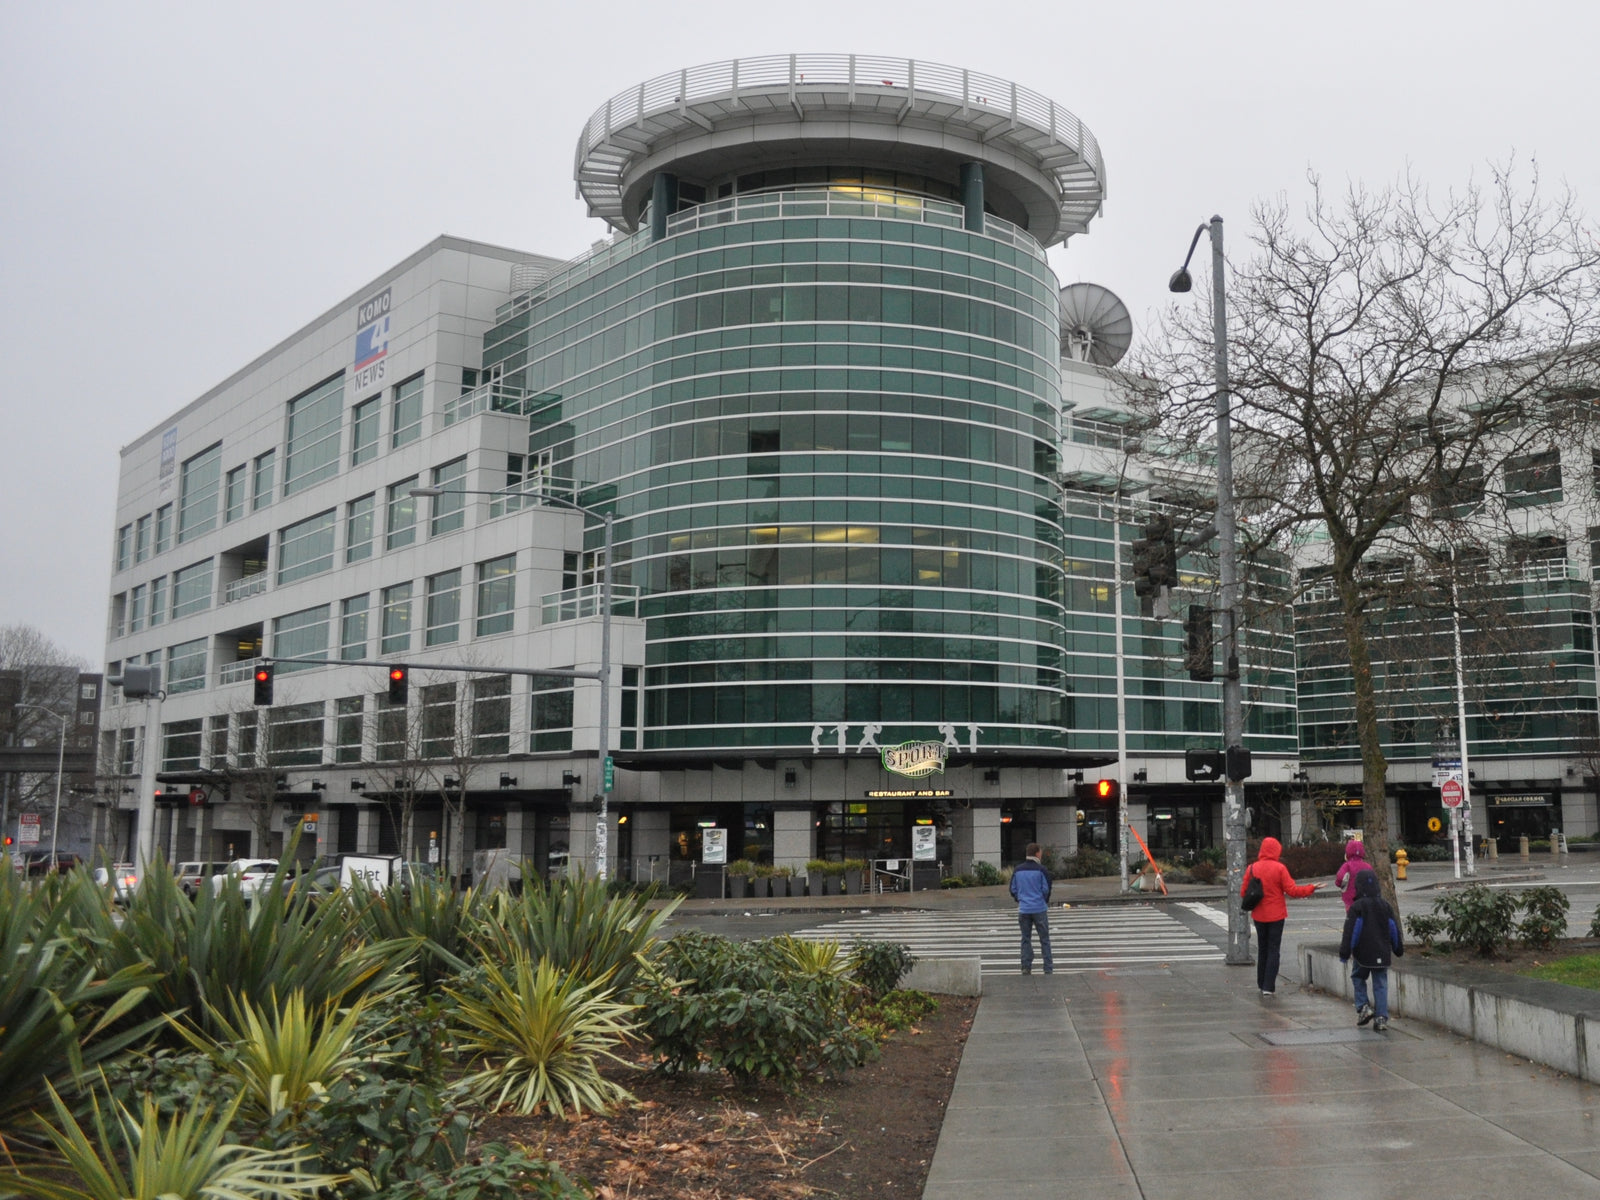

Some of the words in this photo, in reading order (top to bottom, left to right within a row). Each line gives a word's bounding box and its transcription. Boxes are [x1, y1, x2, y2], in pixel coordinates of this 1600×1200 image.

[359, 292, 390, 326] KOMO
[370, 317, 389, 354] 4
[354, 360, 385, 392] NEWS
[886, 744, 947, 767] SPORT
[195, 793, 204, 802] P
[868, 790, 917, 798] RESTAURANT
[350, 865, 380, 881] alet
